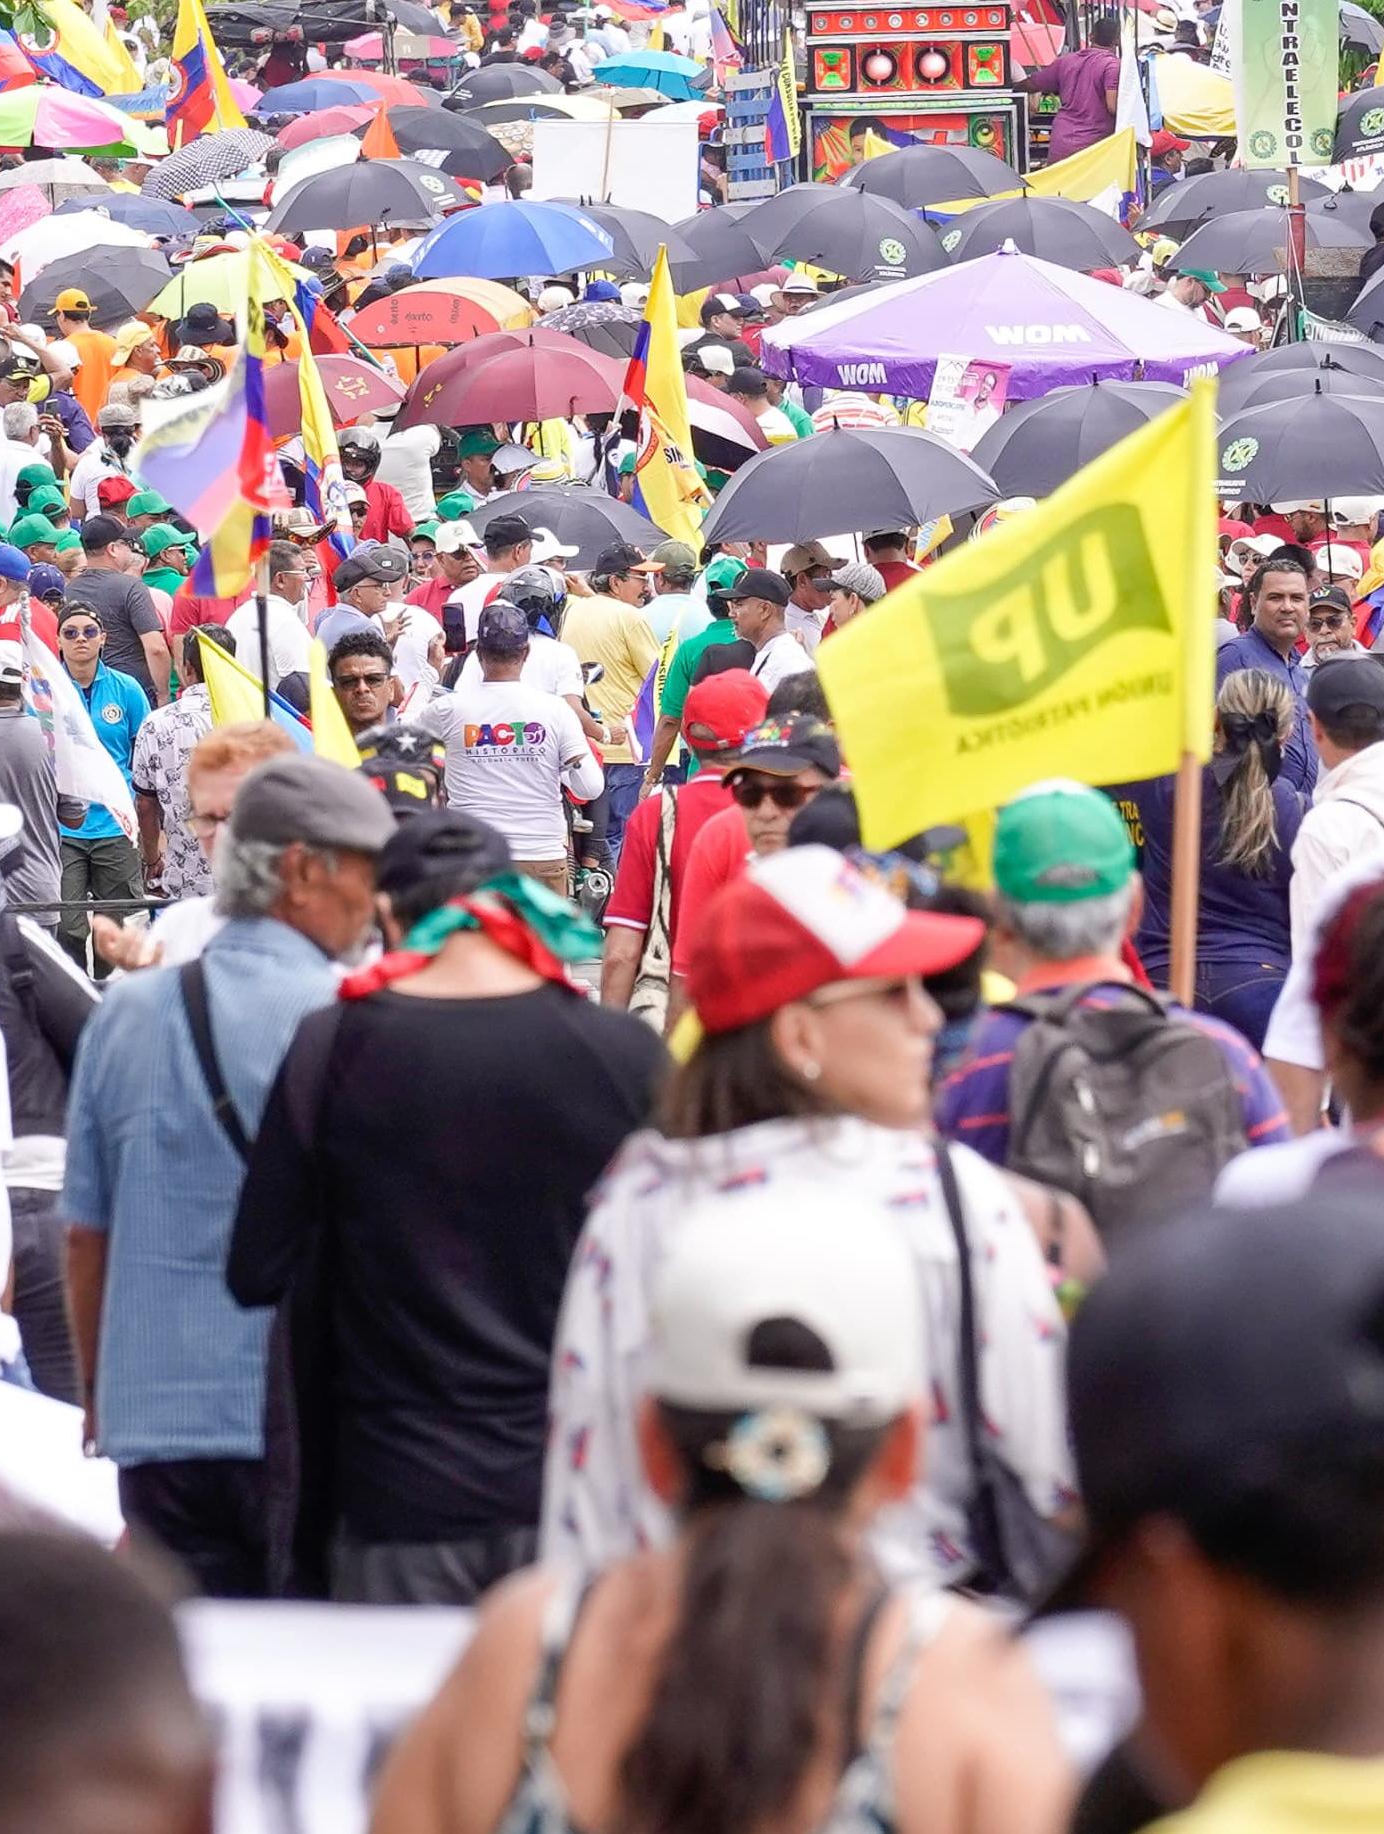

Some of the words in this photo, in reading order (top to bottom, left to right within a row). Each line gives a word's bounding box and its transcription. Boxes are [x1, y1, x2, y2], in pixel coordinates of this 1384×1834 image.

[983, 325, 1093, 344] WOM
[837, 362, 888, 386] WOM
[464, 722, 546, 748] PACTO
